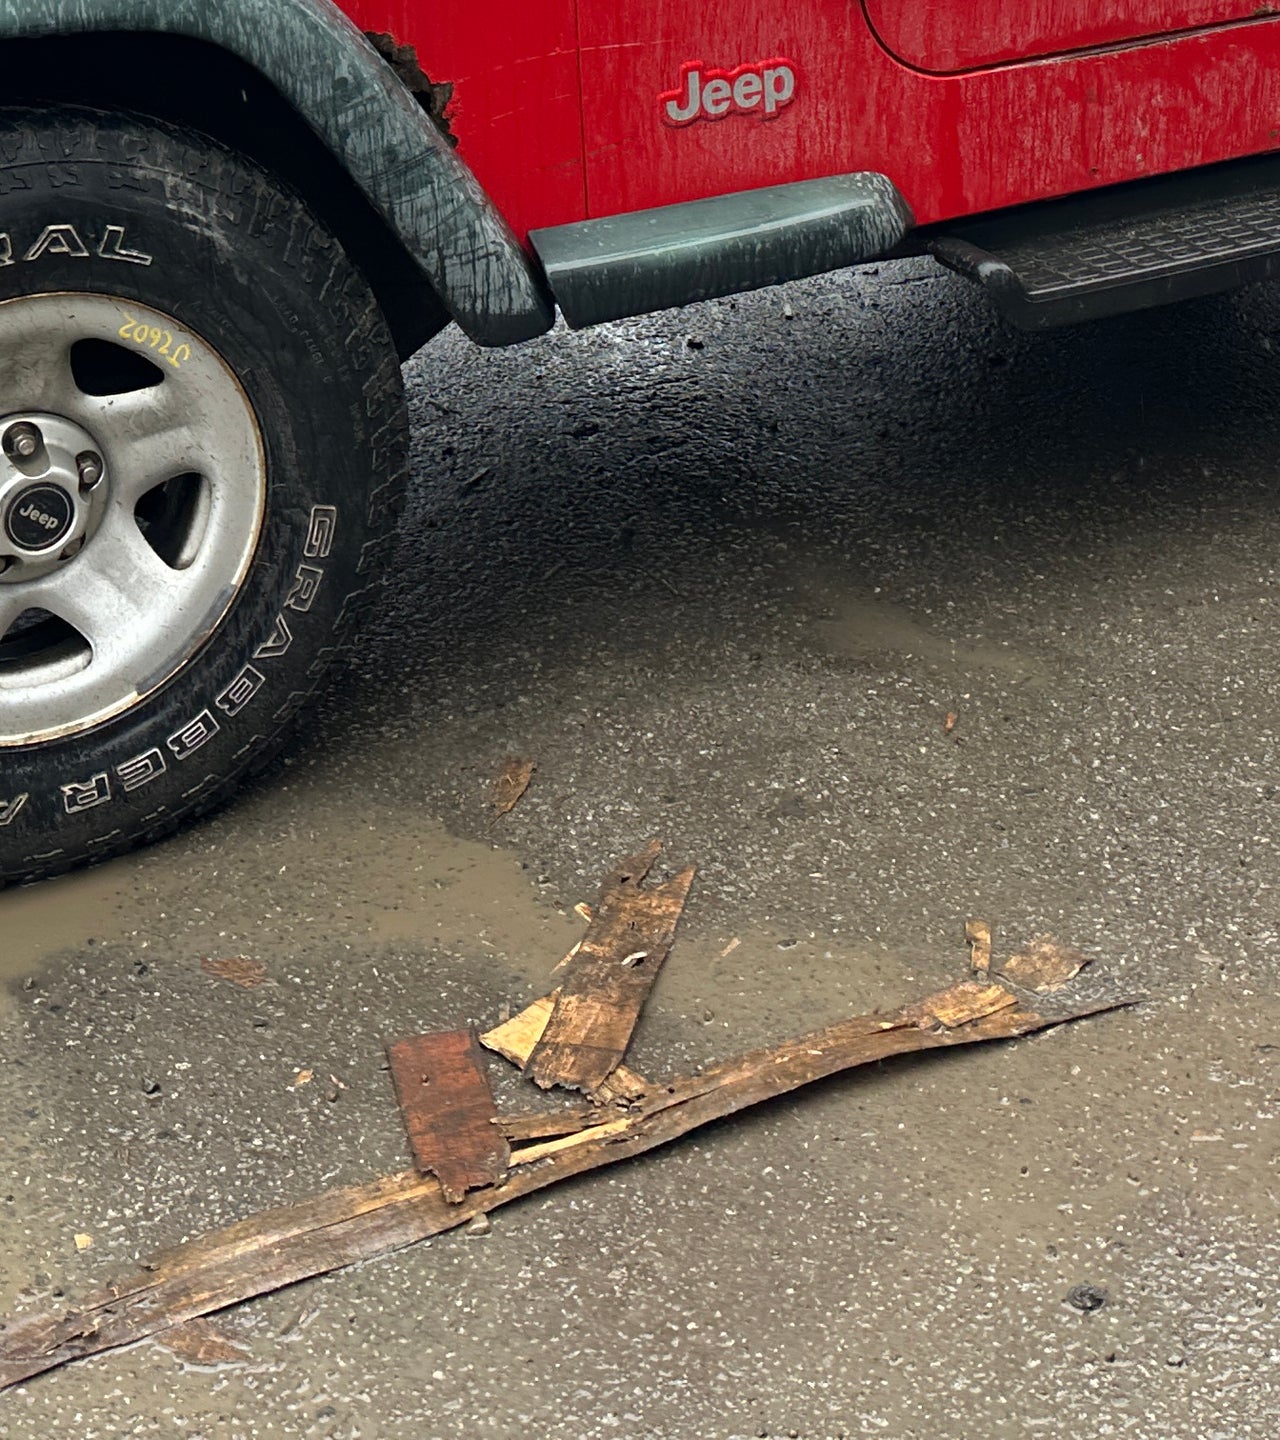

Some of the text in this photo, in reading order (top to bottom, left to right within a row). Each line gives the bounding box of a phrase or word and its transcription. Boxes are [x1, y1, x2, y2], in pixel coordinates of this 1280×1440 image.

[665, 65, 795, 121] Jeep
[118, 311, 191, 369] J2602
[19, 503, 59, 530] Jeep
[61, 504, 337, 816] GRABBER
